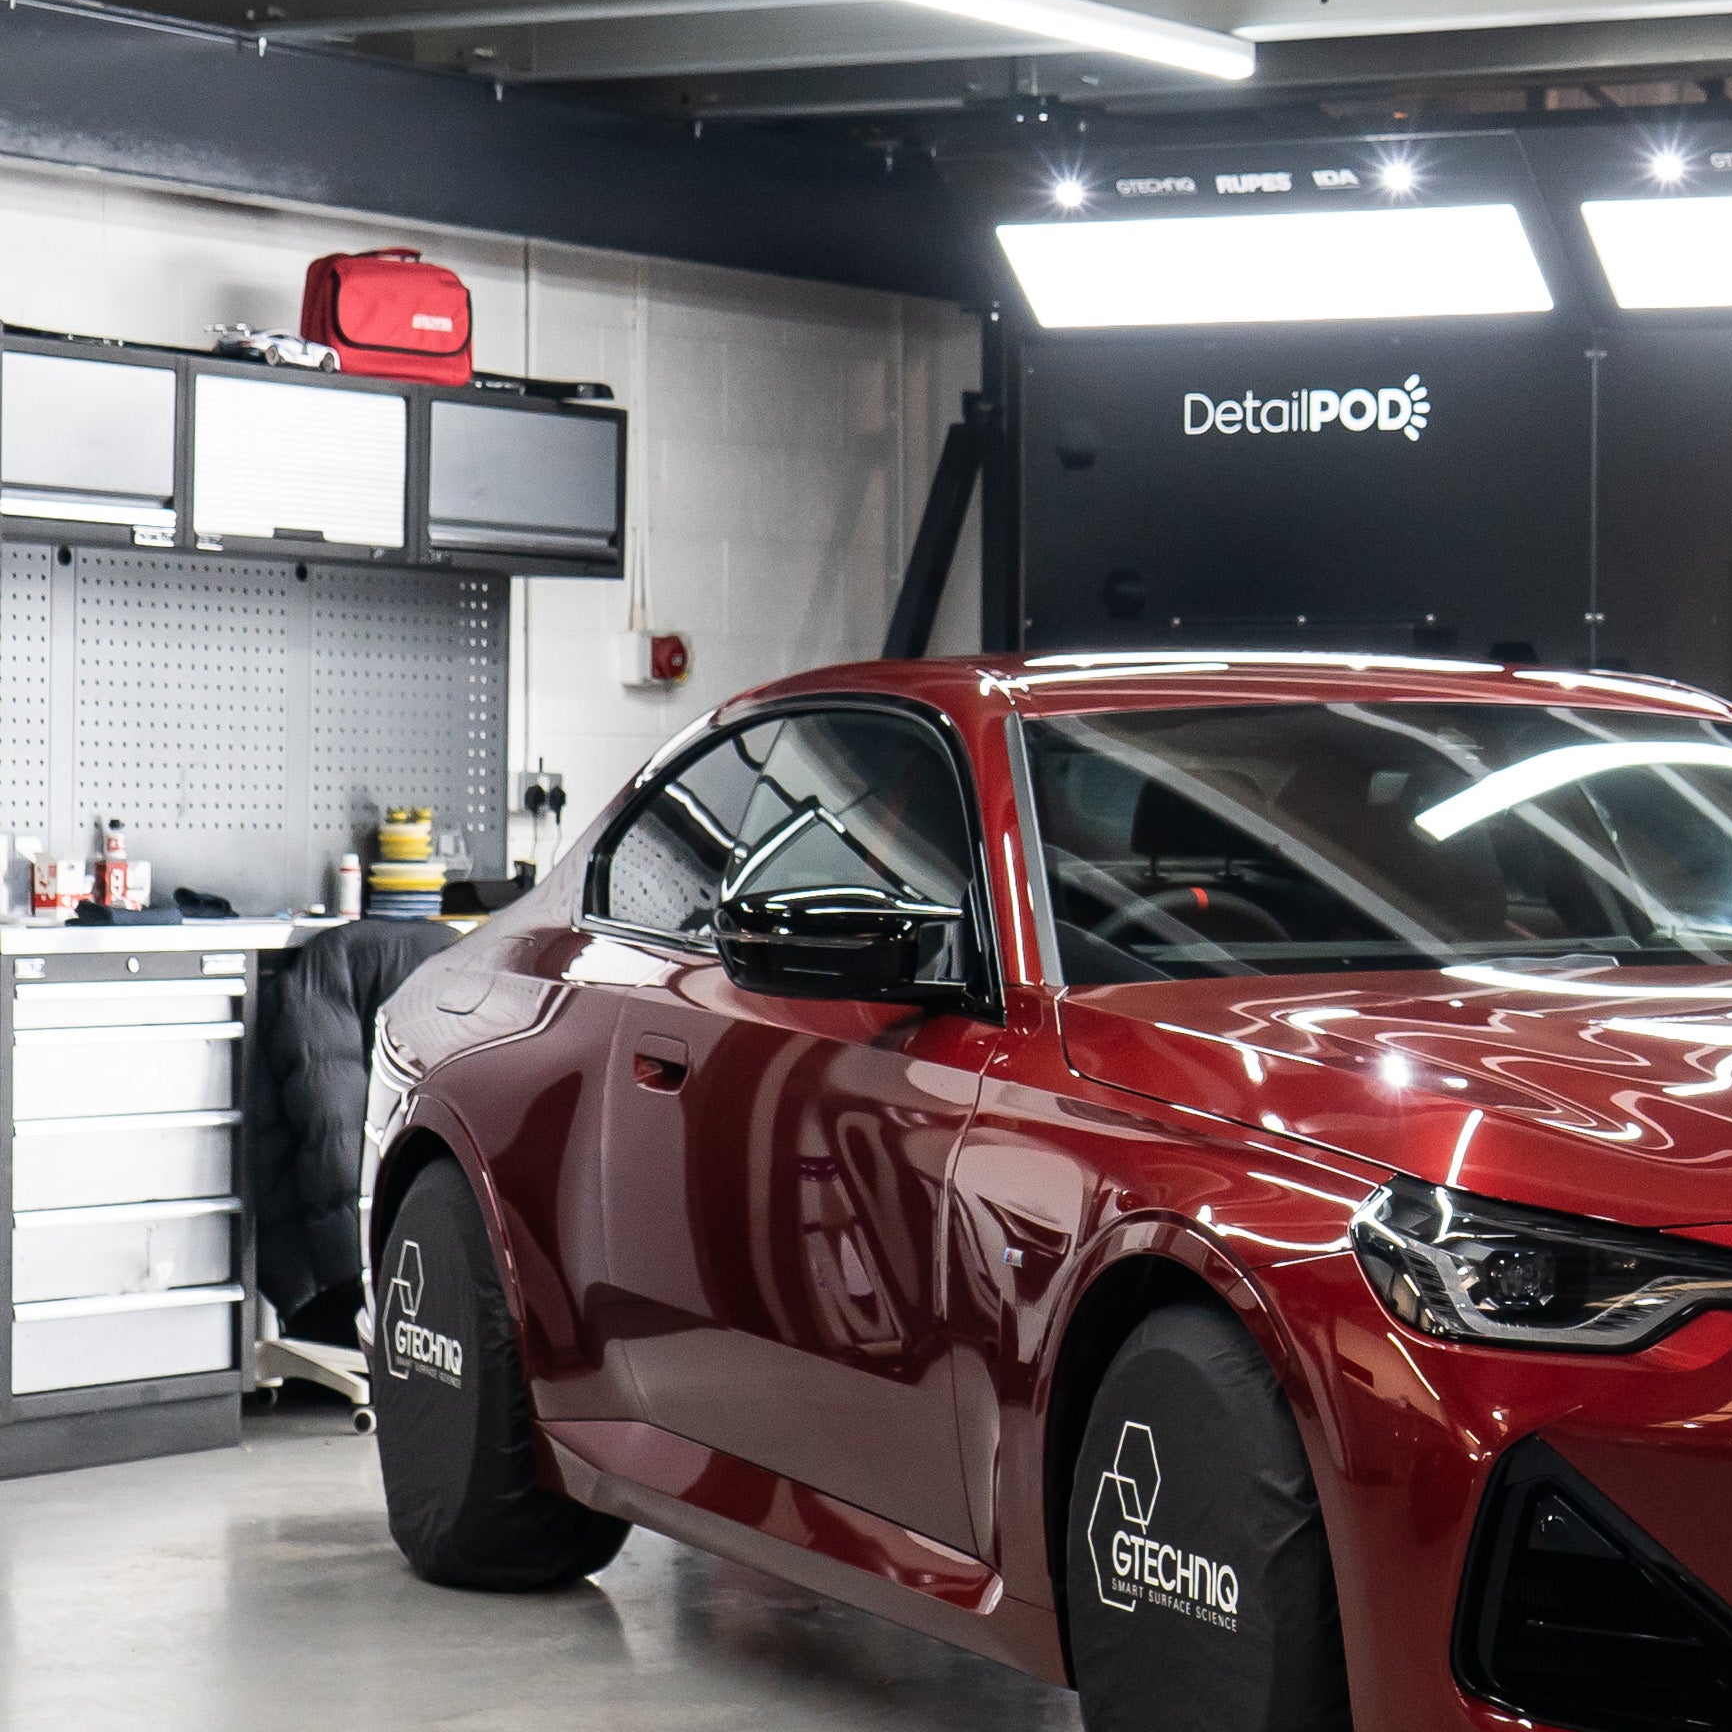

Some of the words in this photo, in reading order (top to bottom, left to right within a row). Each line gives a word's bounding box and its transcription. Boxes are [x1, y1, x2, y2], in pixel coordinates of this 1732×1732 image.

[1215, 171, 1293, 194] RUPES
[1184, 388, 1410, 437] DetailPOD
[1111, 1576, 1144, 1600] SMART
[1148, 1588, 1192, 1616] SURFACE
[1194, 1604, 1238, 1633] SCIENCE
